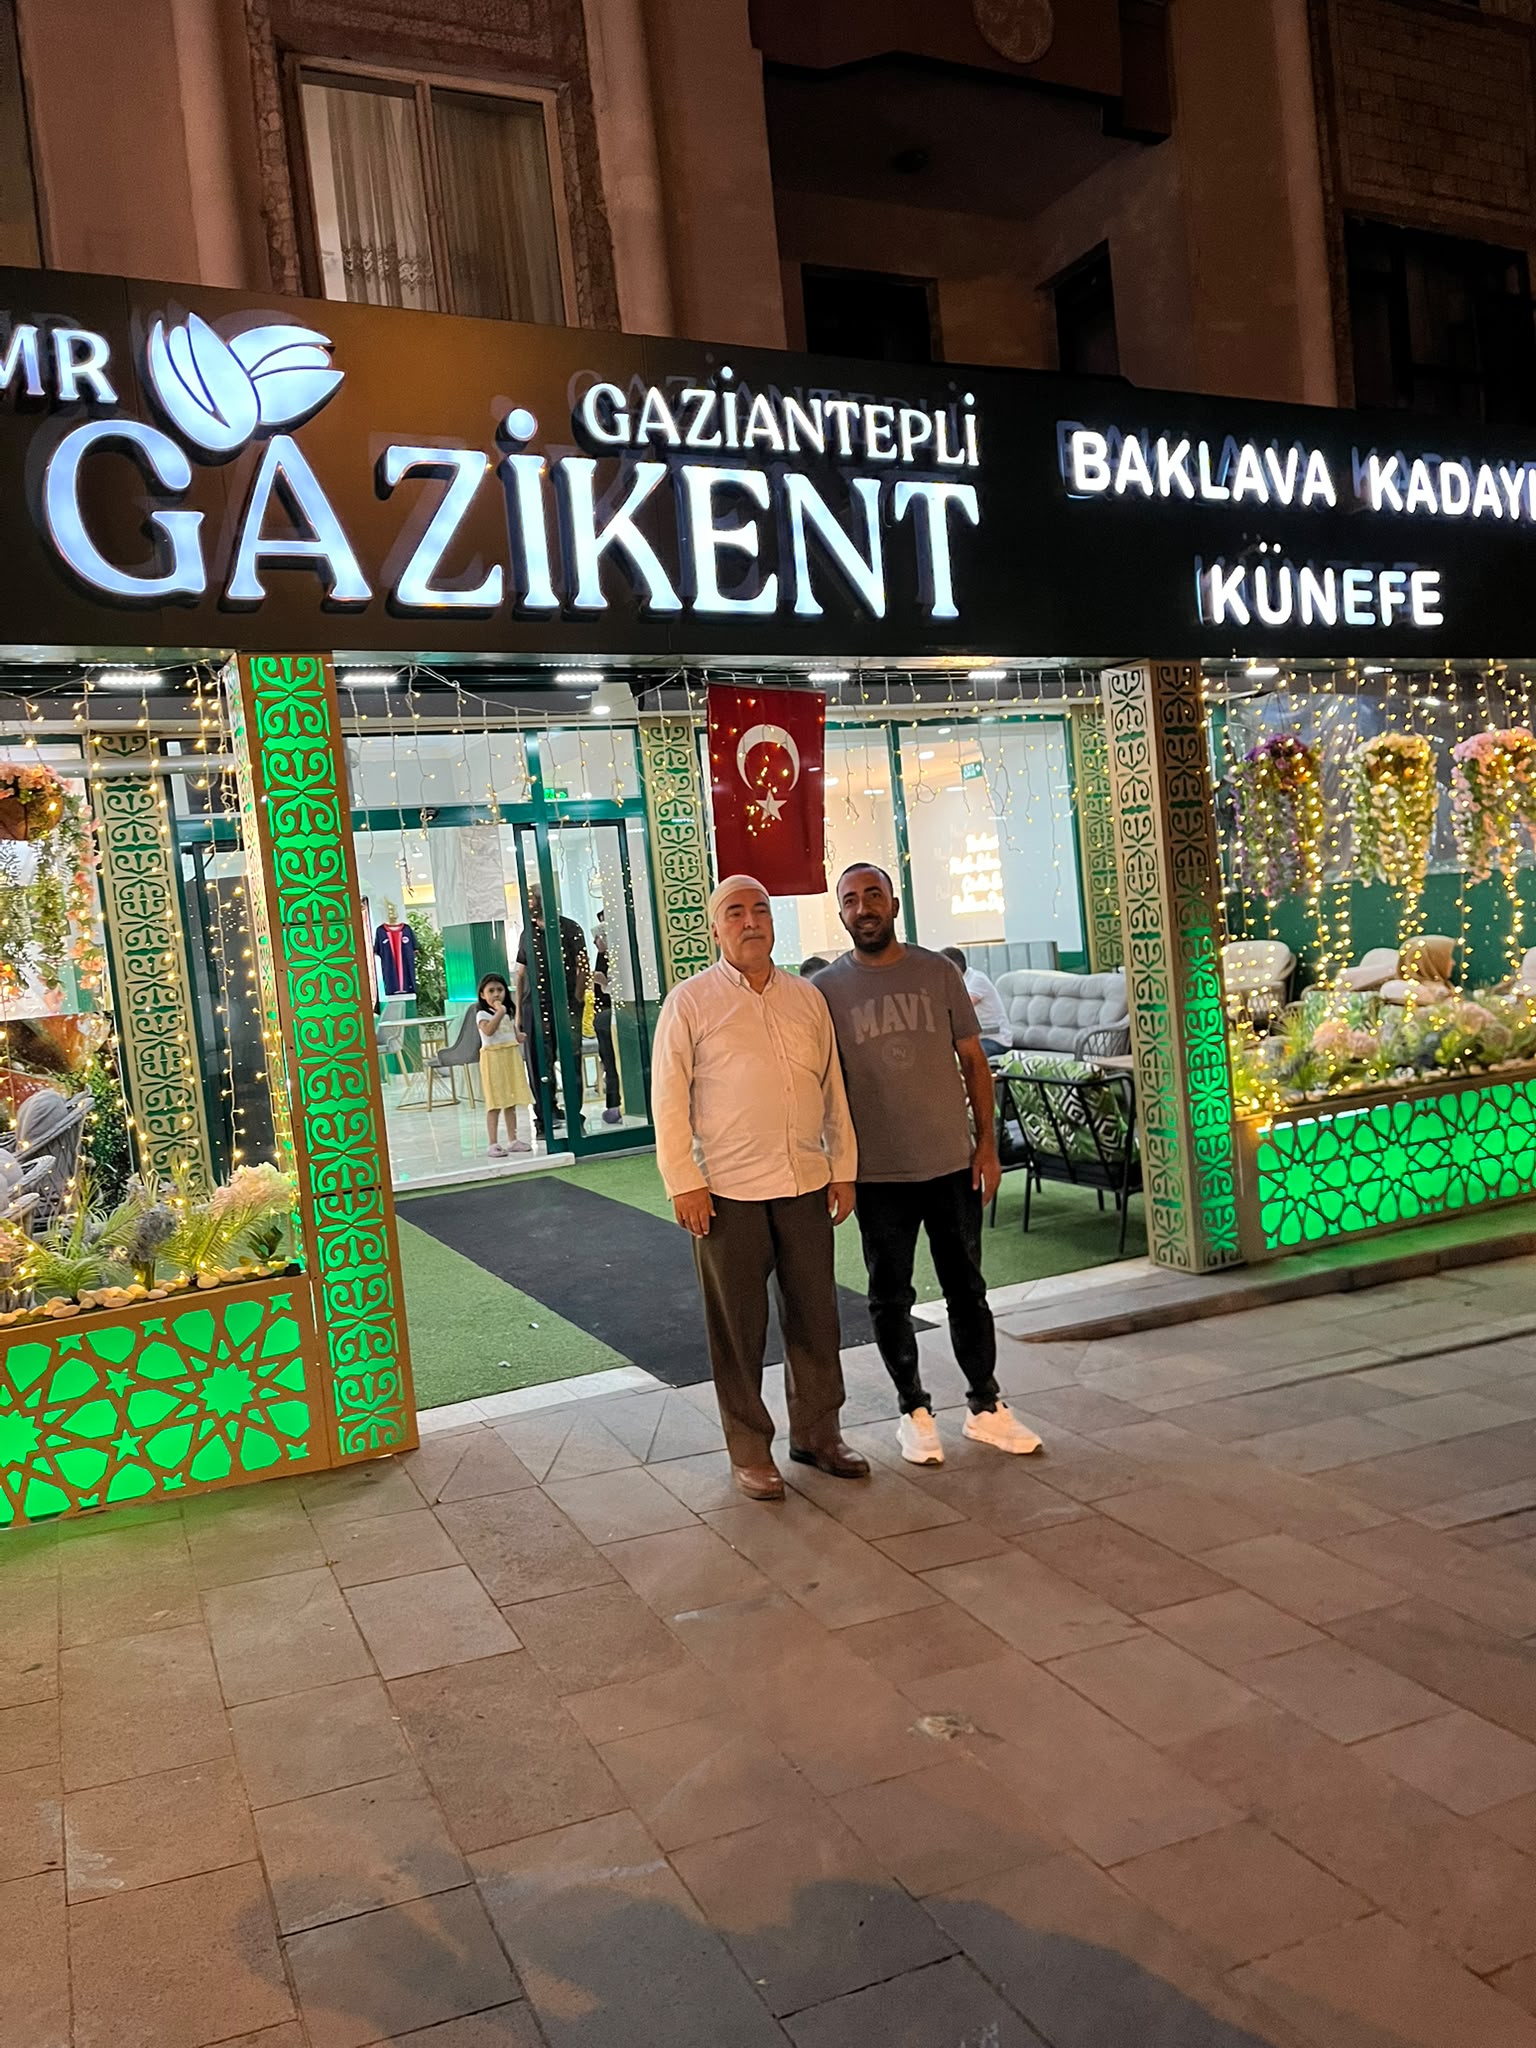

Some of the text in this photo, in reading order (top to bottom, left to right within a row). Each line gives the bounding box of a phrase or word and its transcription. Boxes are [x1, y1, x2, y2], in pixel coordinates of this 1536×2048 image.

[583, 366, 980, 467] GAZİANTEPLİ
[1071, 430, 1337, 508] BAKLAVA
[46, 408, 981, 618] GAZİKENT
[1211, 541, 1444, 626] KÜNEFE
[850, 987, 936, 1045] MAVİ
